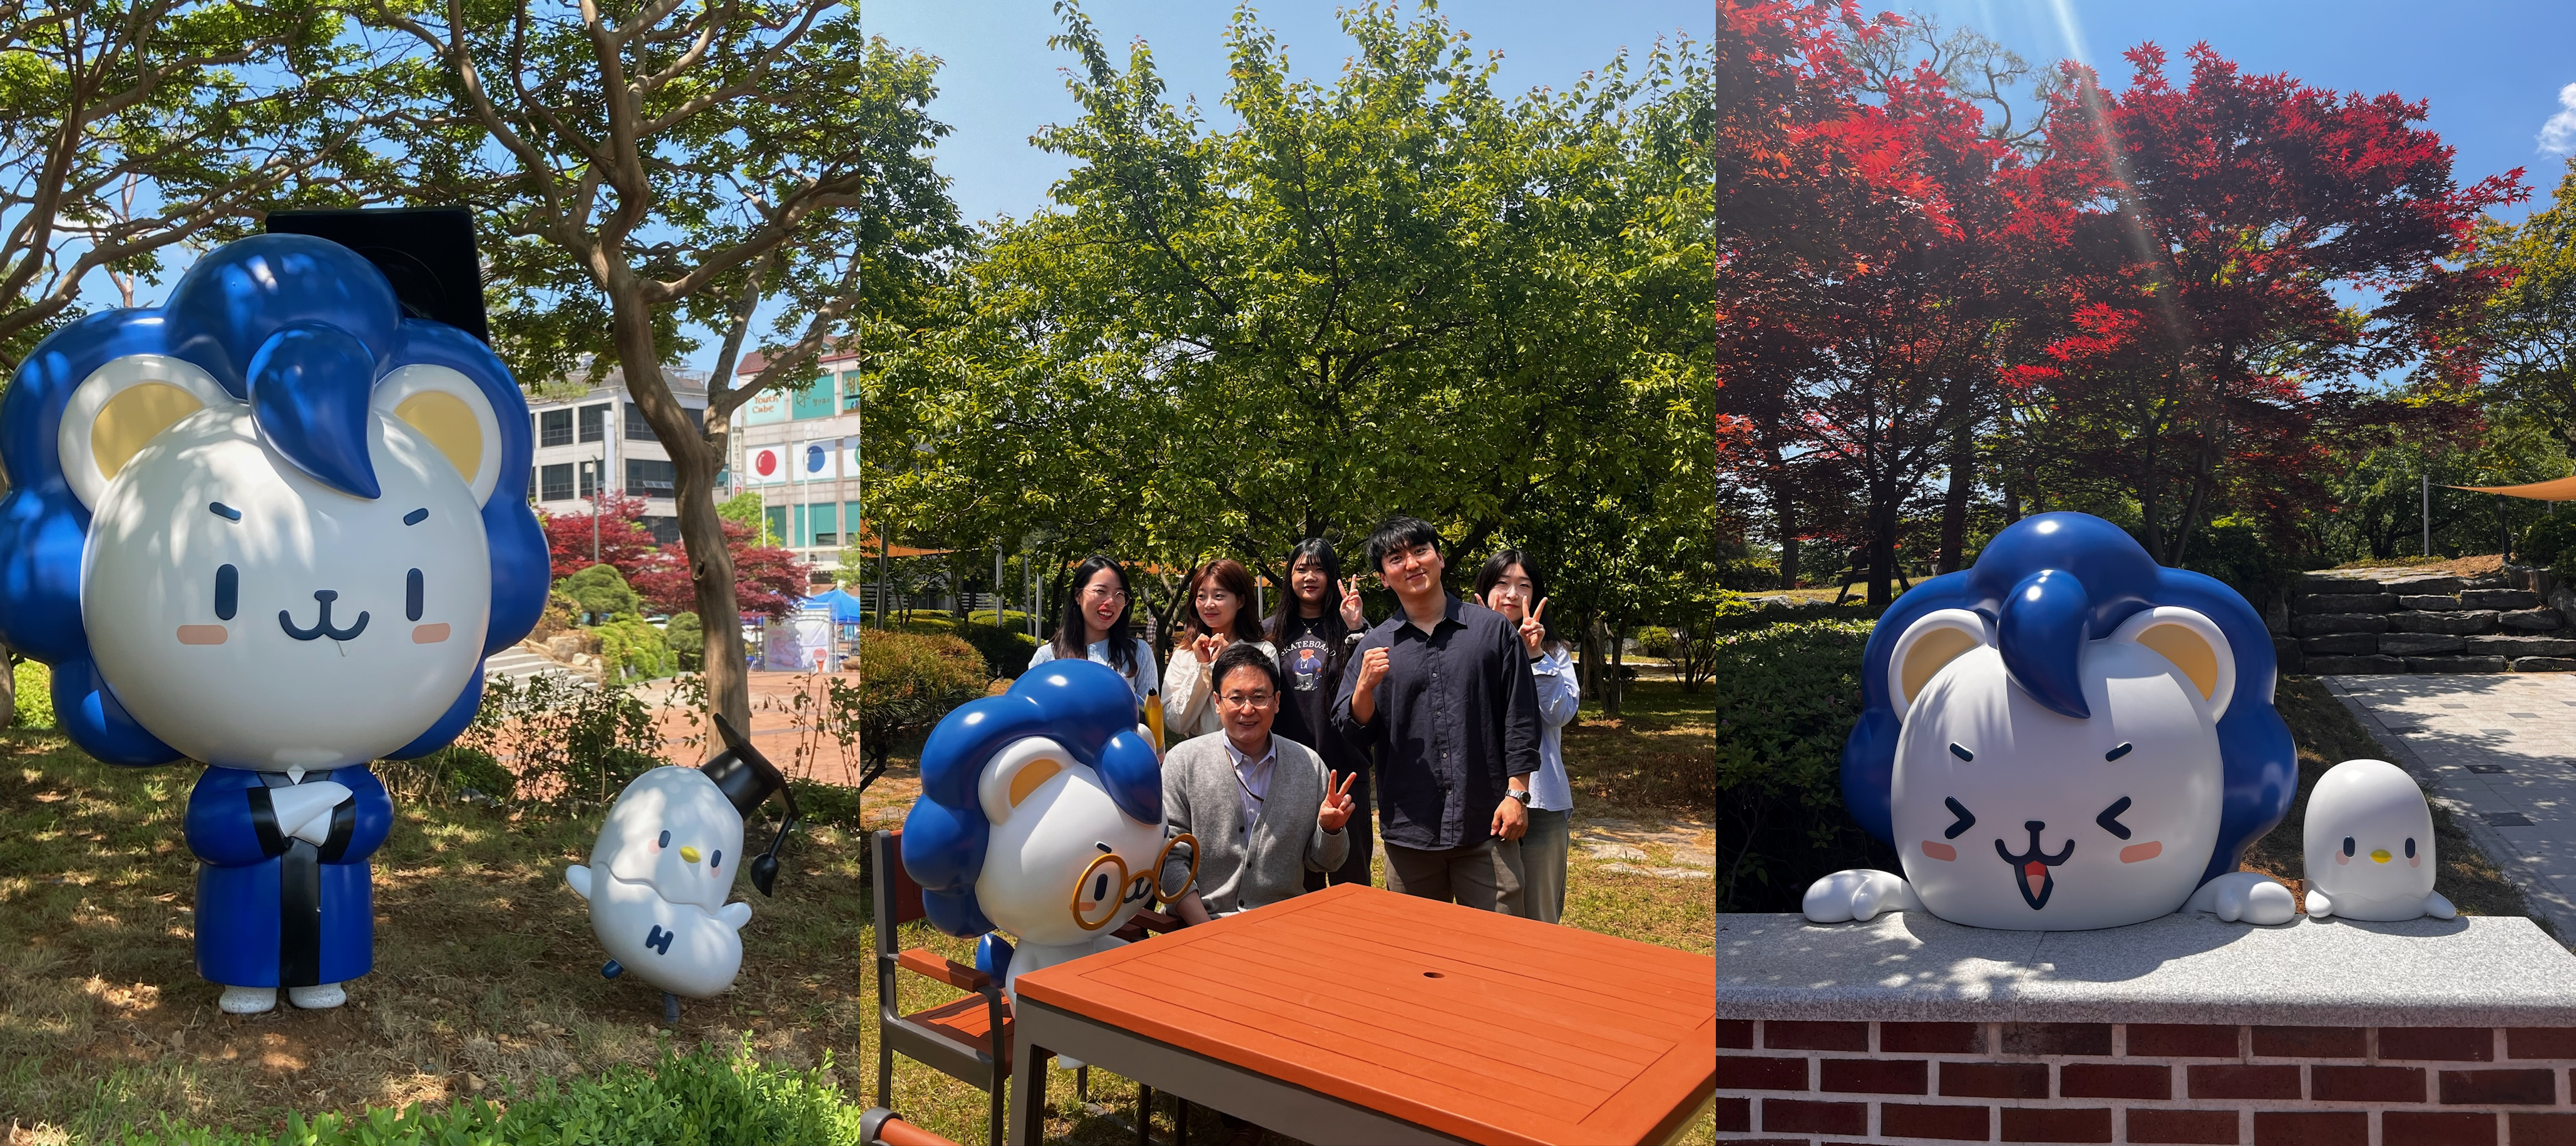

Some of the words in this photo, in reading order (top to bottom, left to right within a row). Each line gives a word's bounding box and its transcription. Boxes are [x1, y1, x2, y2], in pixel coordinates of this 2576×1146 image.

[754, 394, 779, 404] Youth
[752, 405, 774, 414] Cube
[645, 924, 674, 955] H
